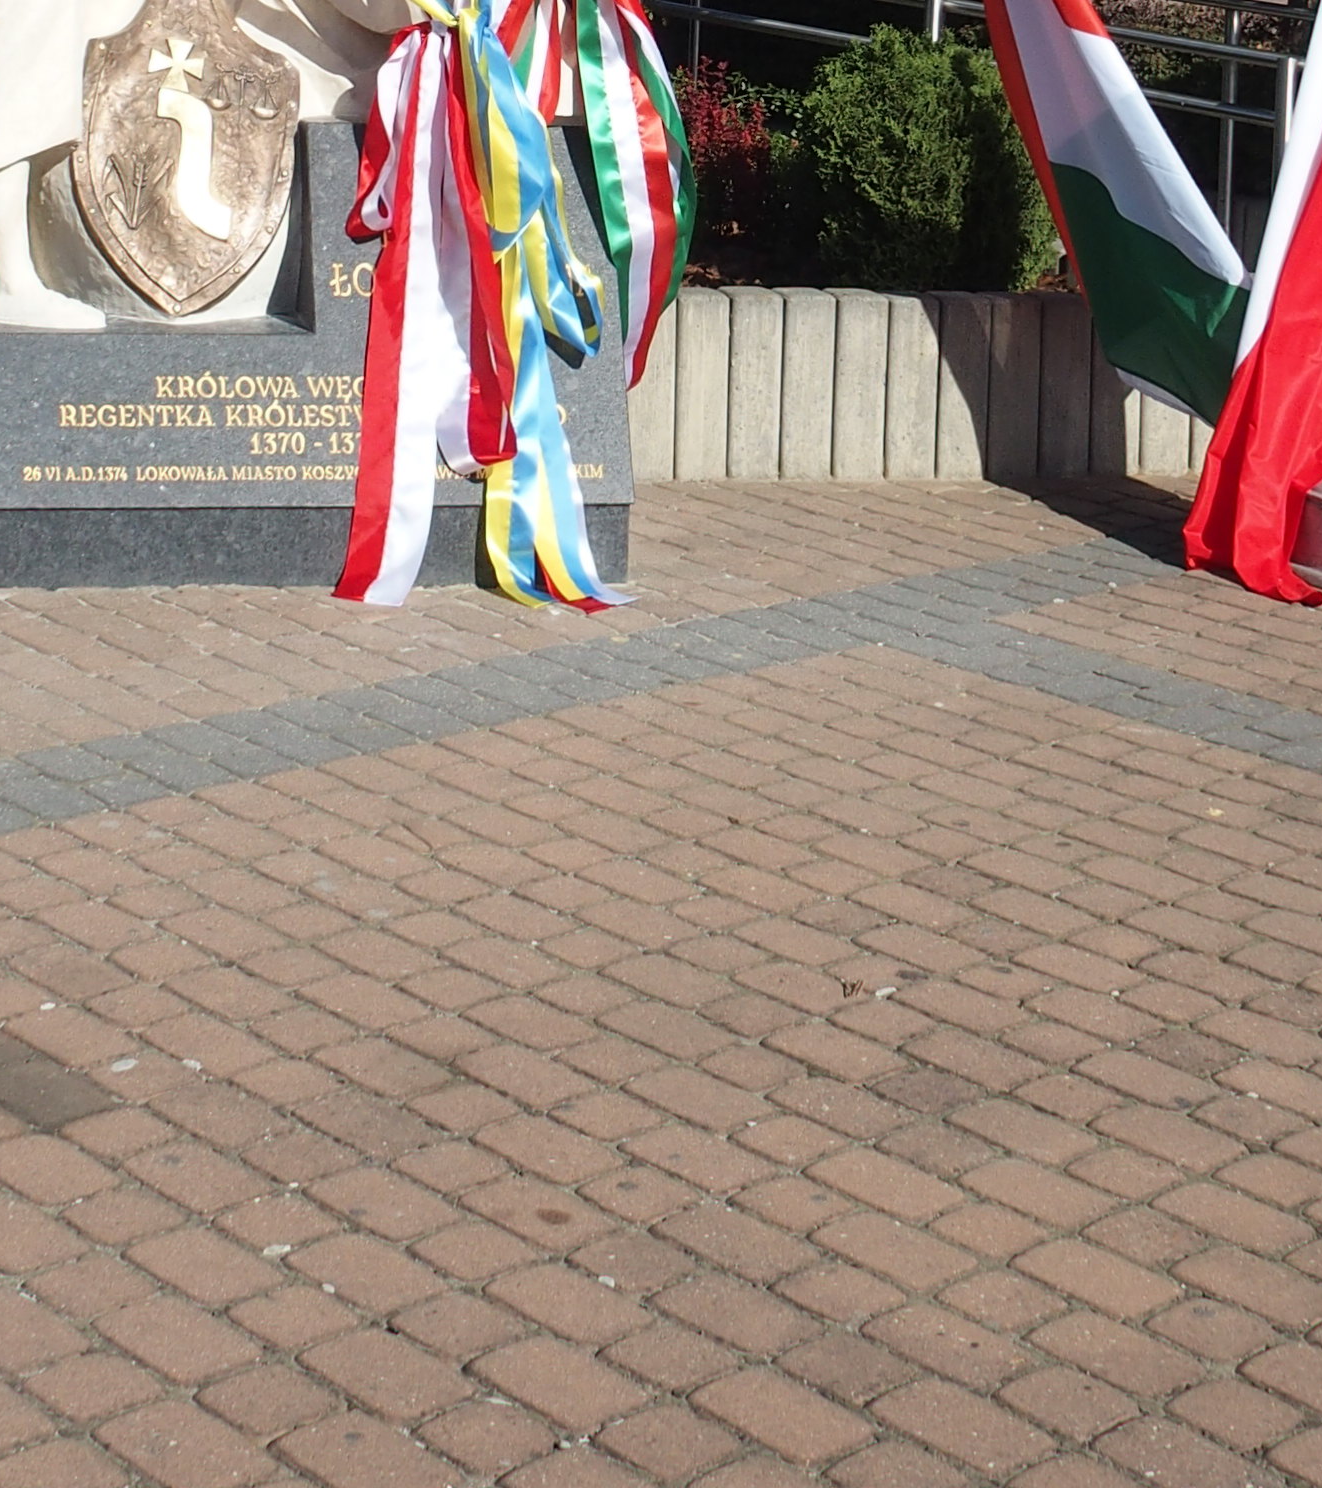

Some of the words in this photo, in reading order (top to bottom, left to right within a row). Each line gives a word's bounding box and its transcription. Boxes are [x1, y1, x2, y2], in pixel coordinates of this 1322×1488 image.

[155, 371, 301, 399] KRÓLOWA
[59, 403, 217, 428] REGENTKA
[225, 397, 362, 428] KRÓLEST
[249, 431, 306, 455] 1370
[22, 465, 42, 482] 26
[44, 465, 61, 482] VI
[135, 465, 229, 482] LOKOWAŁA
[231, 465, 297, 482] MIASTO
